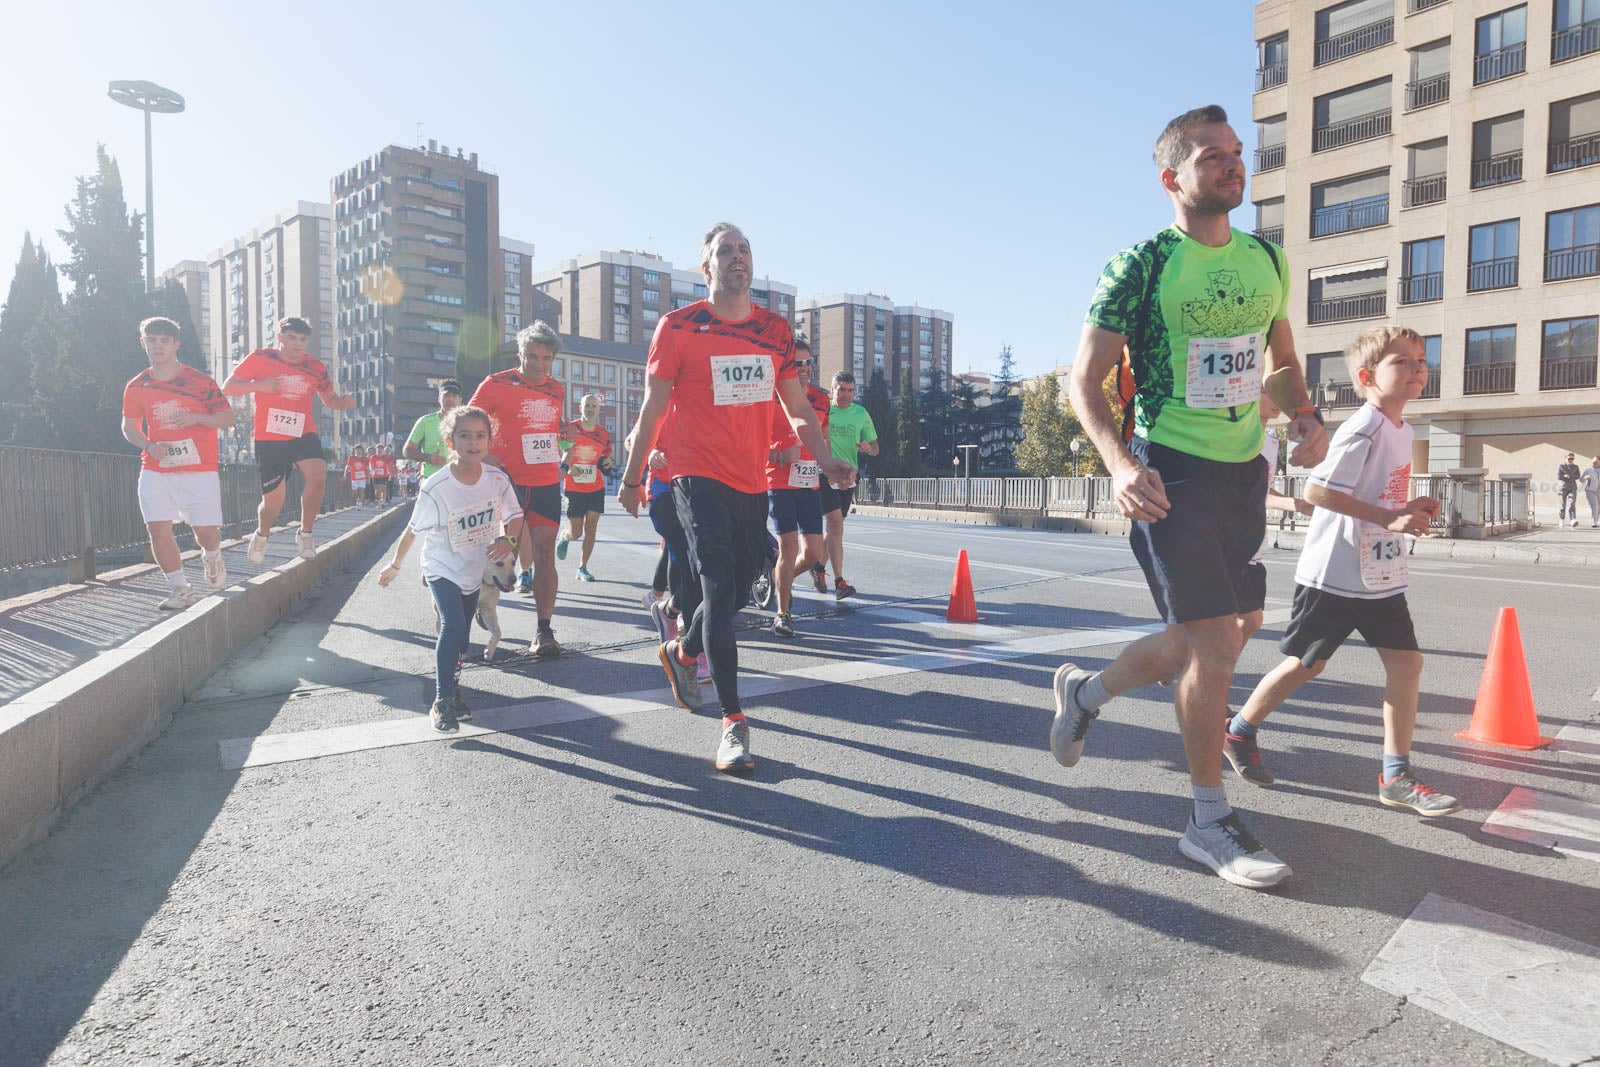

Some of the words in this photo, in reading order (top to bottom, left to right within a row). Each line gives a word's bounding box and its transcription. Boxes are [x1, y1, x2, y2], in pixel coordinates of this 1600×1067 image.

[1203, 349, 1255, 375] 1302
[722, 365, 764, 382] 1074
[273, 414, 297, 425] 1721
[533, 440, 552, 450] 206
[166, 446, 188, 457] 891
[795, 466, 817, 475] 1235
[457, 508, 494, 530] 1077
